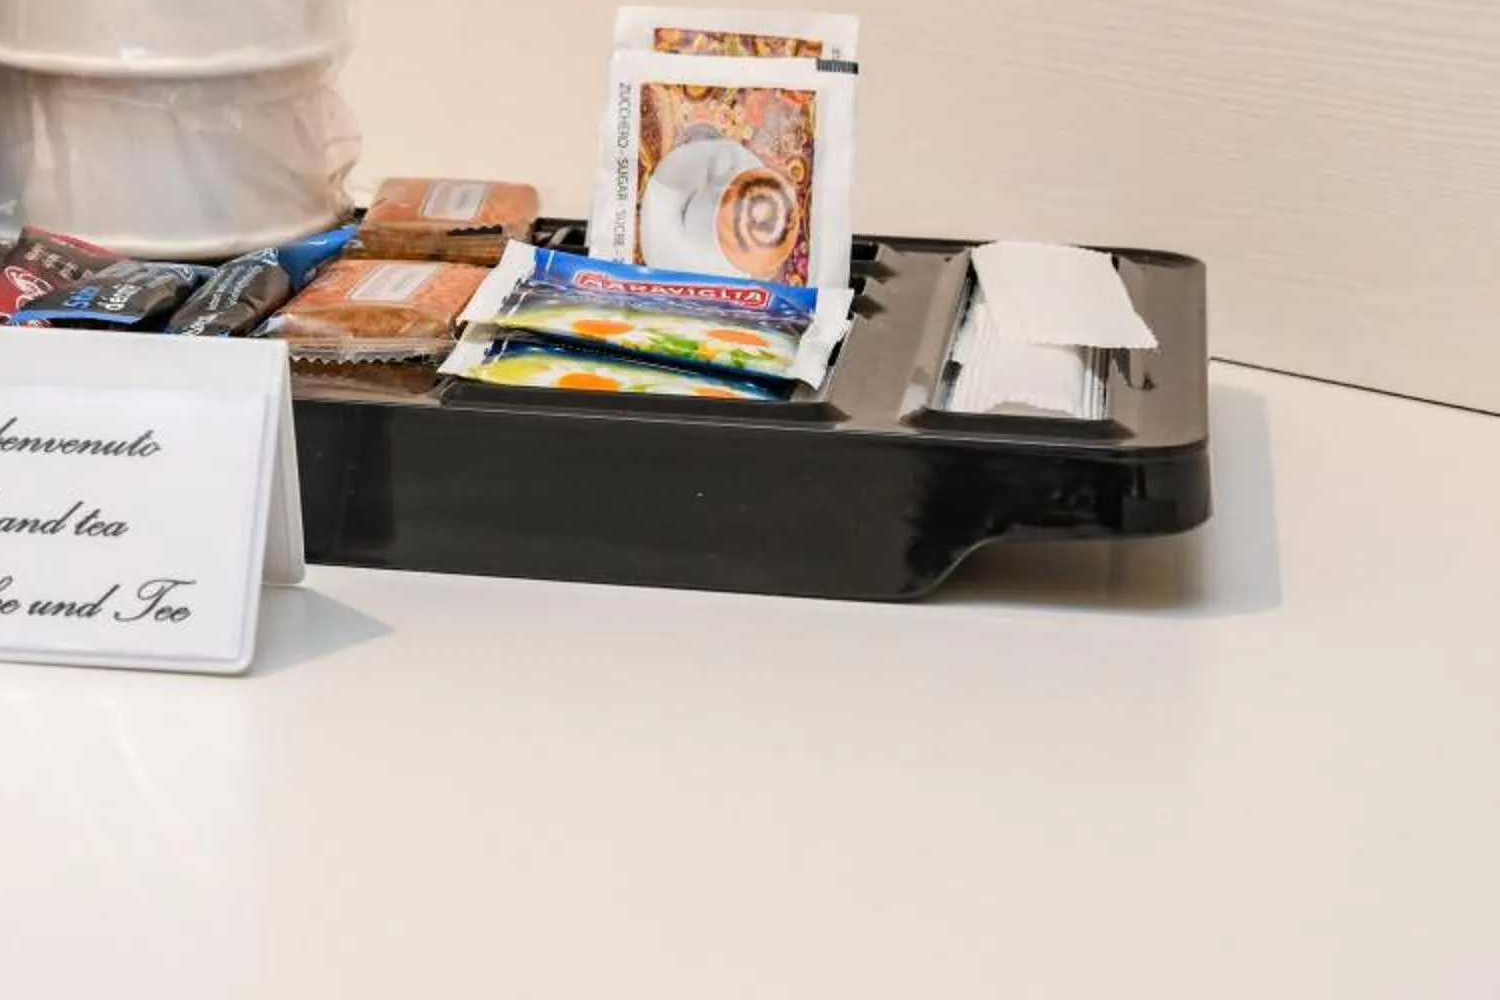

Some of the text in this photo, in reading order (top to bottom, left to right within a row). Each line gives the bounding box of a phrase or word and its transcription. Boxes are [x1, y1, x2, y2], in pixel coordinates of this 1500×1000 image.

[615, 158, 629, 201] SUGAR
[73, 508, 130, 538] tea
[27, 583, 121, 620] und
[112, 578, 198, 624] Tee
